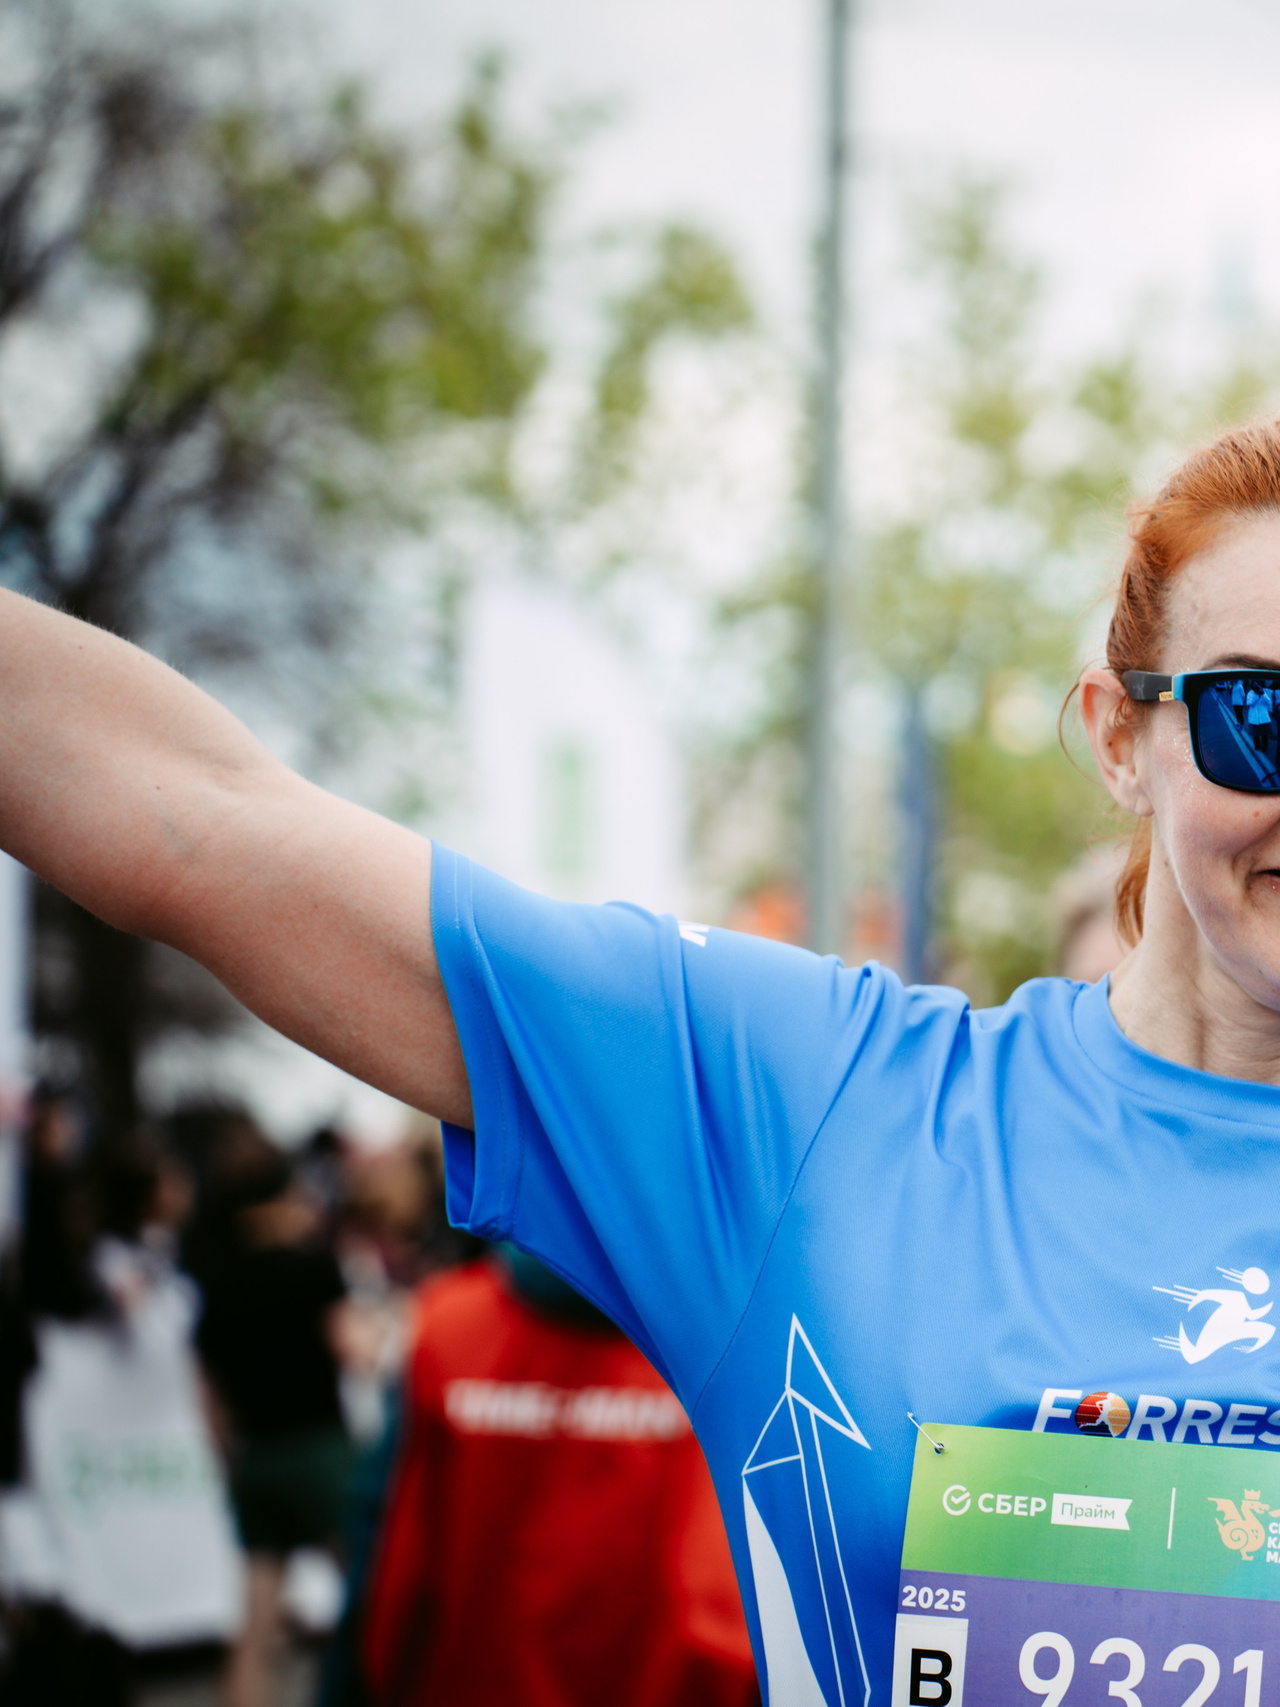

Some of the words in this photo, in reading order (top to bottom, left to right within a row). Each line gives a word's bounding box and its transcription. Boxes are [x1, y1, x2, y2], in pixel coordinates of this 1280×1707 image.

[978, 1492, 1047, 1517] СБЕР
[1061, 1502, 1115, 1520] Прайм
[902, 1585, 966, 1612] 2025
[909, 1647, 953, 1707] B
[1018, 1631, 1264, 1707] 9321
